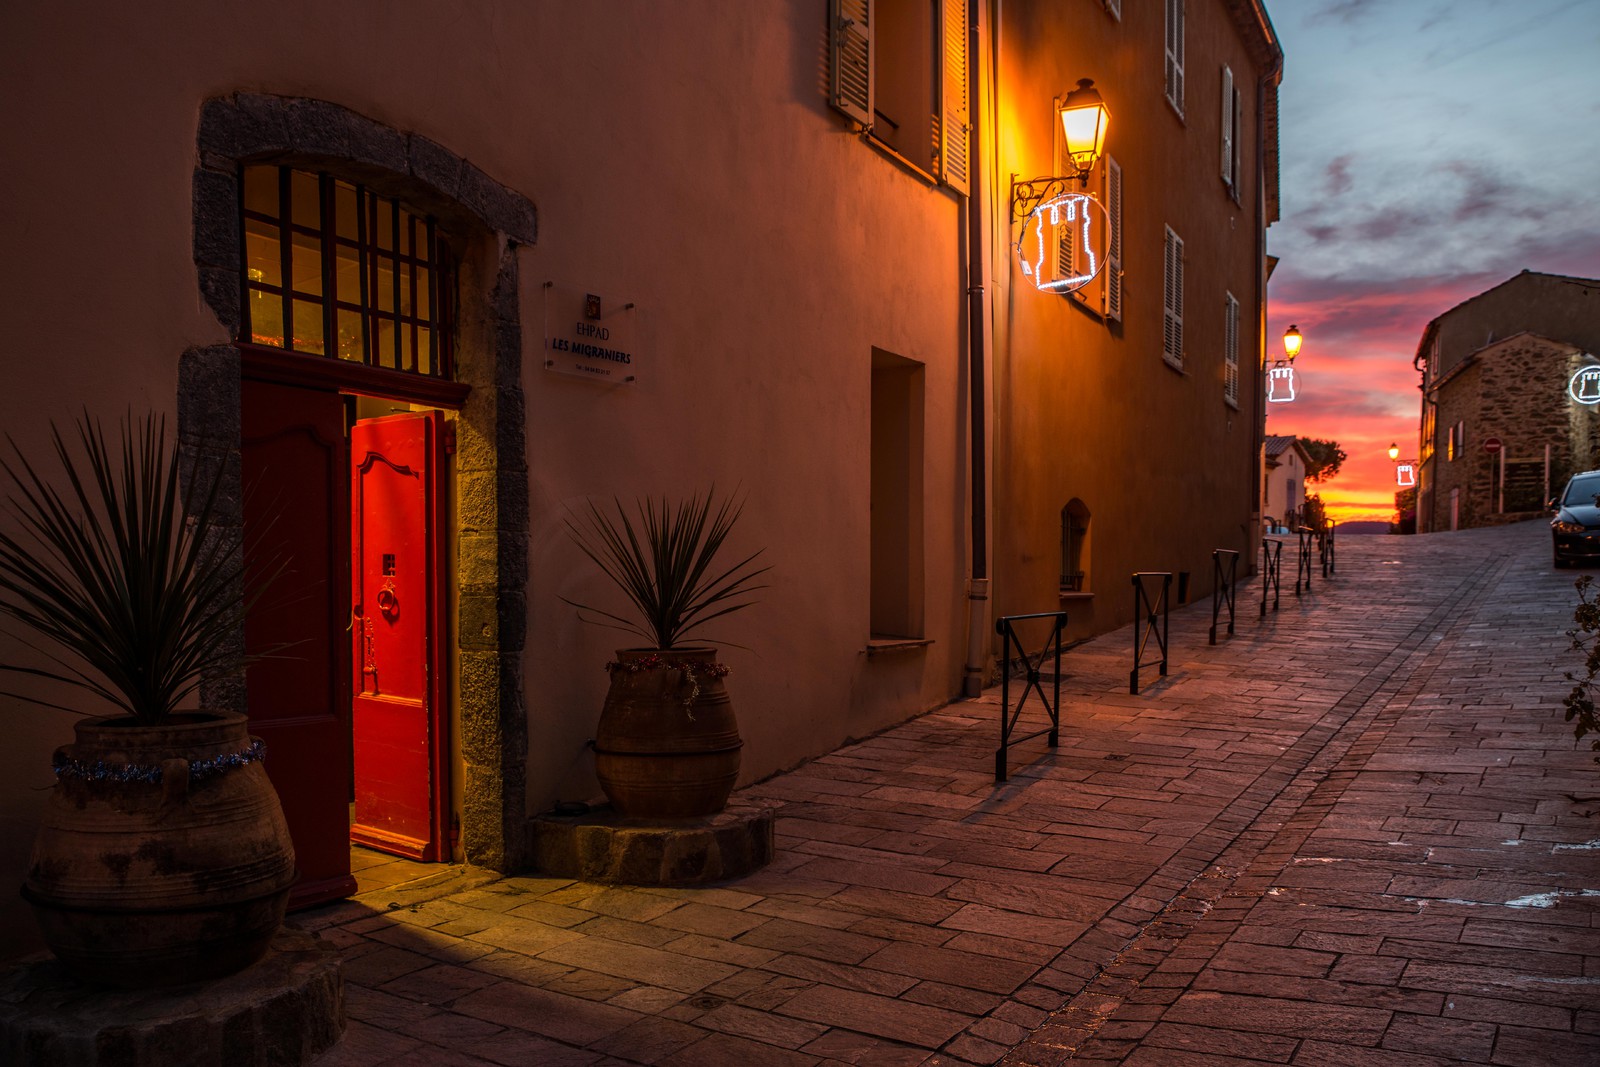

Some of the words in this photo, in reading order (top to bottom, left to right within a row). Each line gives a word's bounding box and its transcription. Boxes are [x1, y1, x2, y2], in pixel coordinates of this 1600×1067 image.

[577, 322, 610, 341] EHPAD
[552, 338, 569, 351] LES
[571, 342, 631, 364] MIGRANIERS
